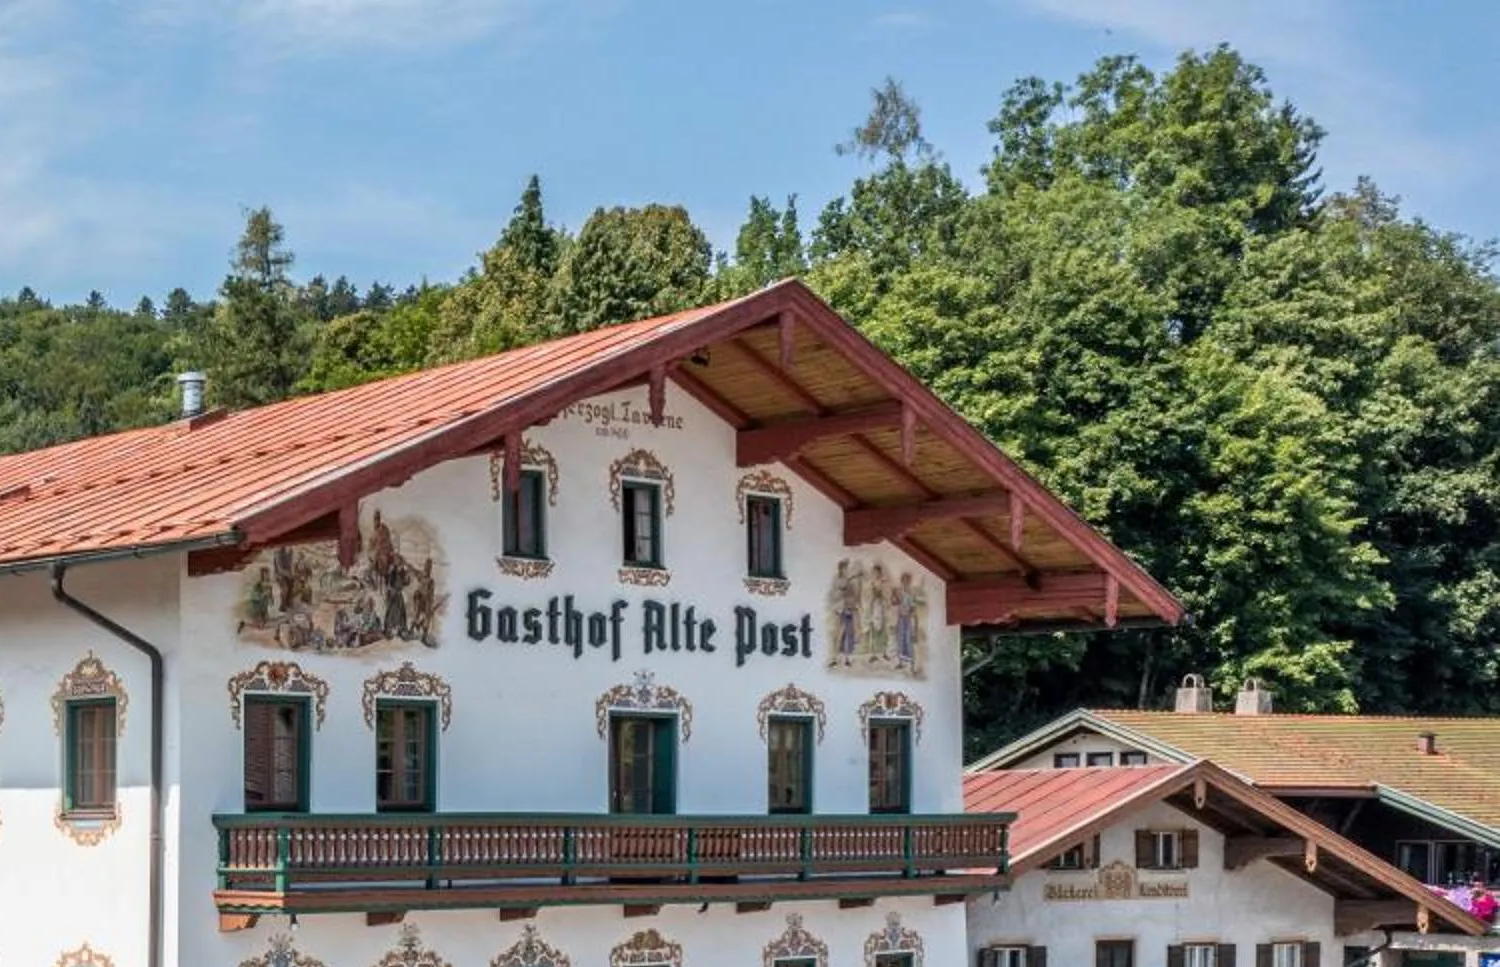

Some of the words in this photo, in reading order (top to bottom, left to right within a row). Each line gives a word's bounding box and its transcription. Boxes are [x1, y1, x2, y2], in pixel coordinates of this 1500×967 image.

[466, 588, 629, 662] Gasthof
[643, 598, 717, 655] Alte
[734, 605, 814, 668] Post
